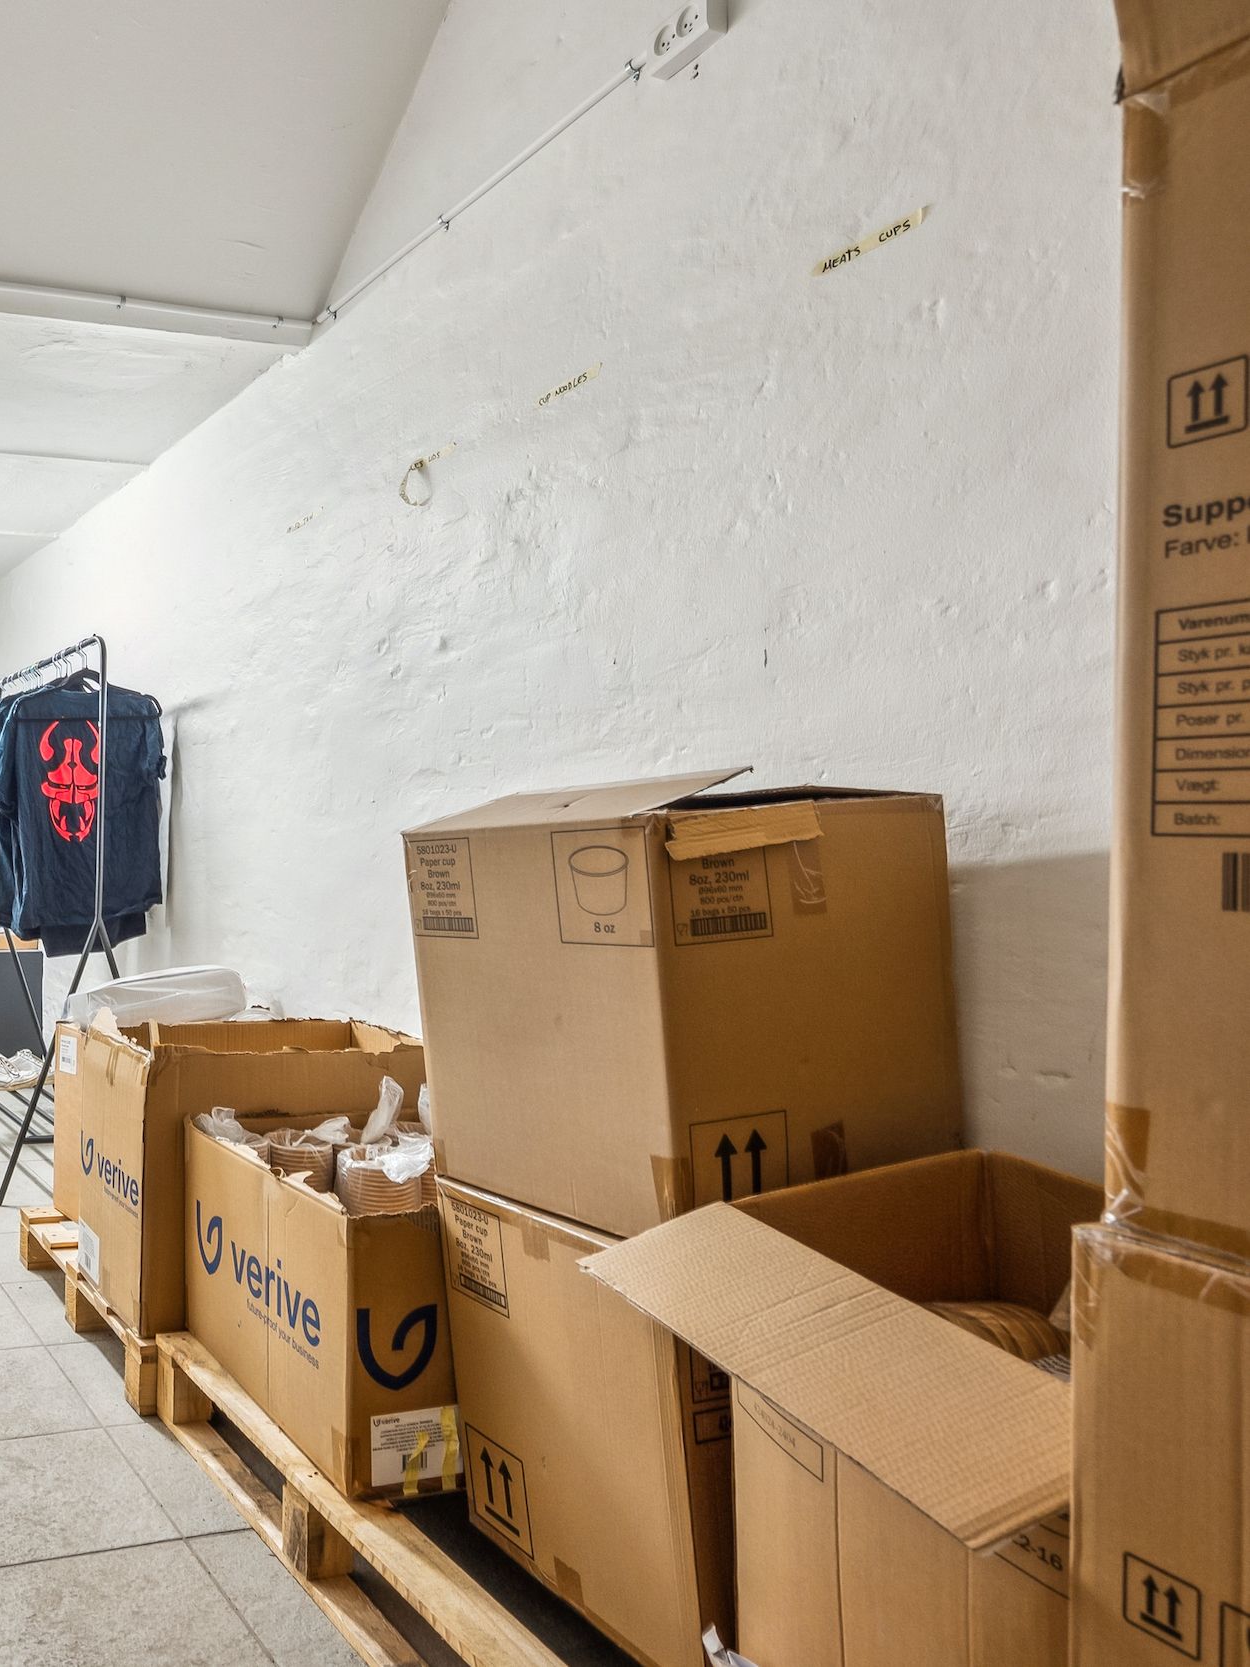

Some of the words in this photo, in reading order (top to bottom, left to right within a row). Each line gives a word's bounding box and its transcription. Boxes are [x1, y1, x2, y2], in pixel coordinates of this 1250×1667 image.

[822, 246, 861, 273] MEATS
[878, 219, 911, 243] CUPS
[554, 372, 588, 397] NOODLES
[1162, 495, 1250, 528] Supp
[1164, 531, 1240, 559] Farve:
[1177, 648, 1209, 663] Styk
[1214, 646, 1233, 661] pr.
[1177, 680, 1209, 696] Styk
[1215, 680, 1234, 694] pr.
[1175, 713, 1220, 727] Poser
[1226, 712, 1246, 727] pr.
[1175, 778, 1219, 794] Vægt:
[1173, 811, 1220, 826] Batch:
[416, 844, 457, 855] 5801023-U
[420, 858, 441, 868] Paper
[442, 858, 456, 867] cup
[701, 858, 734, 870] Brown
[427, 869, 450, 878] Brown
[714, 870, 749, 883] 230ml
[436, 881, 460, 890] 230ml
[594, 921, 601, 933] 8
[603, 924, 616, 934] oz
[97, 1152, 139, 1207] verive
[451, 1201, 489, 1225] 5801023-U
[454, 1214, 474, 1232] Paper
[475, 1225, 488, 1238] cup
[462, 1228, 483, 1246] Brown
[471, 1245, 493, 1262] 230ml
[230, 1240, 321, 1347] verive
[246, 1298, 278, 1333] future-proof
[278, 1327, 291, 1346] your
[291, 1337, 320, 1370] business
